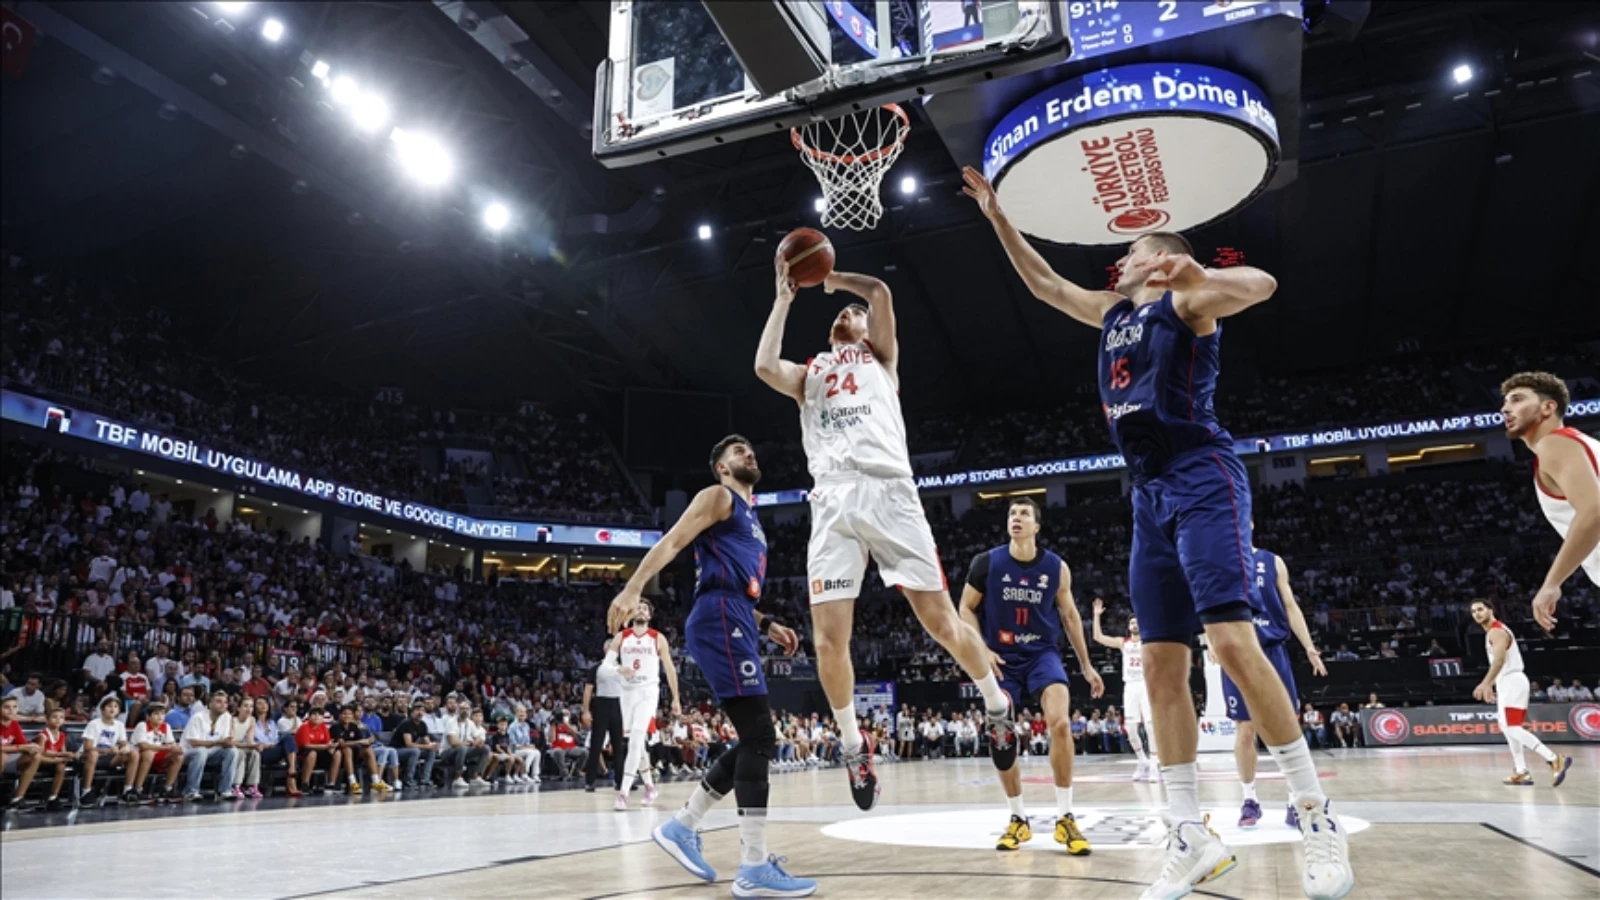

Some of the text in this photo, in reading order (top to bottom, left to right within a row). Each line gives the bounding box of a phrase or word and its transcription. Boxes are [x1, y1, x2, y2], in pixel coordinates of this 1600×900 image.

[1158, 1, 1179, 21] 2
[989, 114, 1039, 165] Sinan
[1045, 80, 1143, 124] Erdem
[1153, 76, 1238, 108] Dome
[1081, 136, 1129, 214] TÜRKİYE
[1113, 131, 1152, 207] BASKETBOL
[1135, 127, 1171, 205] FEDERASYONU
[824, 371, 858, 399] 24
[1110, 357, 1131, 390] 15
[831, 404, 871, 421] Garanti
[1283, 435, 1310, 449] TBF
[1312, 429, 1357, 446] MOBİL
[1358, 418, 1440, 440] UYGULAMA
[1442, 416, 1471, 430] APP
[1473, 412, 1505, 427] STO
[95, 418, 138, 446] TBF
[140, 432, 203, 464] MOBİL
[206, 450, 301, 490] UYGULAMA
[303, 477, 335, 501] APP
[336, 486, 382, 511] STORE
[384, 499, 402, 516] VE
[403, 504, 455, 530] GOOGLE
[945, 473, 967, 486] APP
[969, 469, 1006, 483] STORE
[1008, 467, 1025, 478] VE
[1027, 460, 1078, 476] GOOGLE
[1016, 607, 1029, 626] 11
[632, 658, 641, 671] 6
[773, 664, 791, 676] 113
[1433, 661, 1461, 677] 111
[1412, 721, 1487, 736] SADECE
